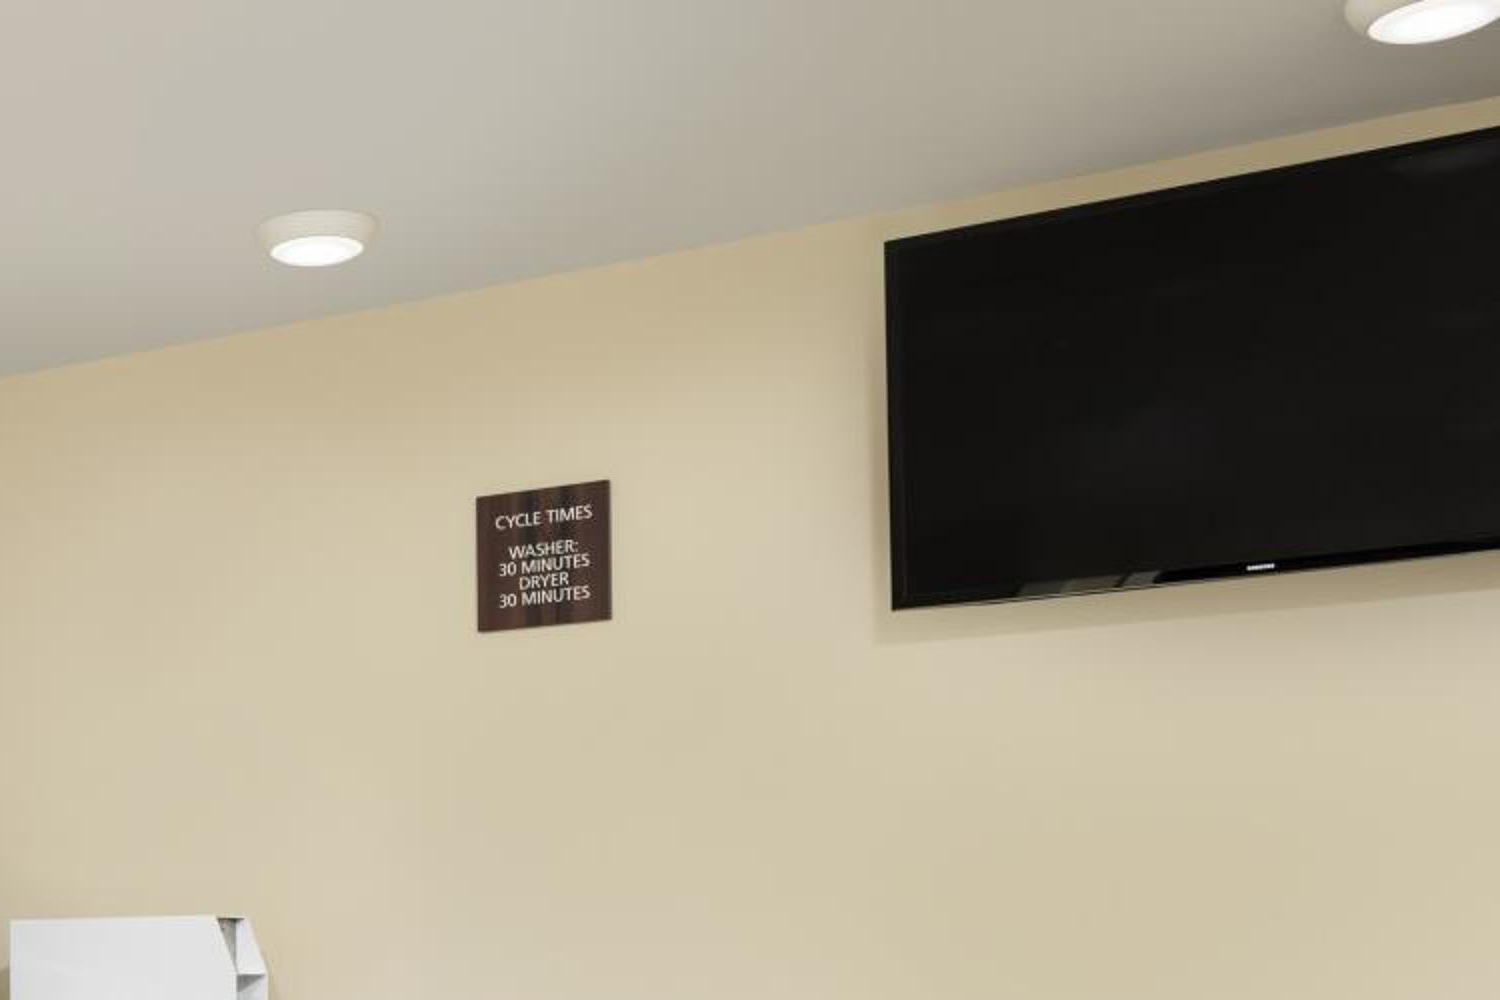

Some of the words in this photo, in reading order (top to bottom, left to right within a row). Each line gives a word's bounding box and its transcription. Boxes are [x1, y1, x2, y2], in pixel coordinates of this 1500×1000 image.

[495, 511, 541, 530] CYCLE
[547, 504, 593, 523] TIMES
[509, 539, 579, 560] WASHER:
[499, 562, 517, 577] 30
[521, 553, 591, 575] MINUTES
[519, 572, 569, 591] DRYER
[499, 593, 517, 608] 30
[521, 585, 591, 607] MINUTES
